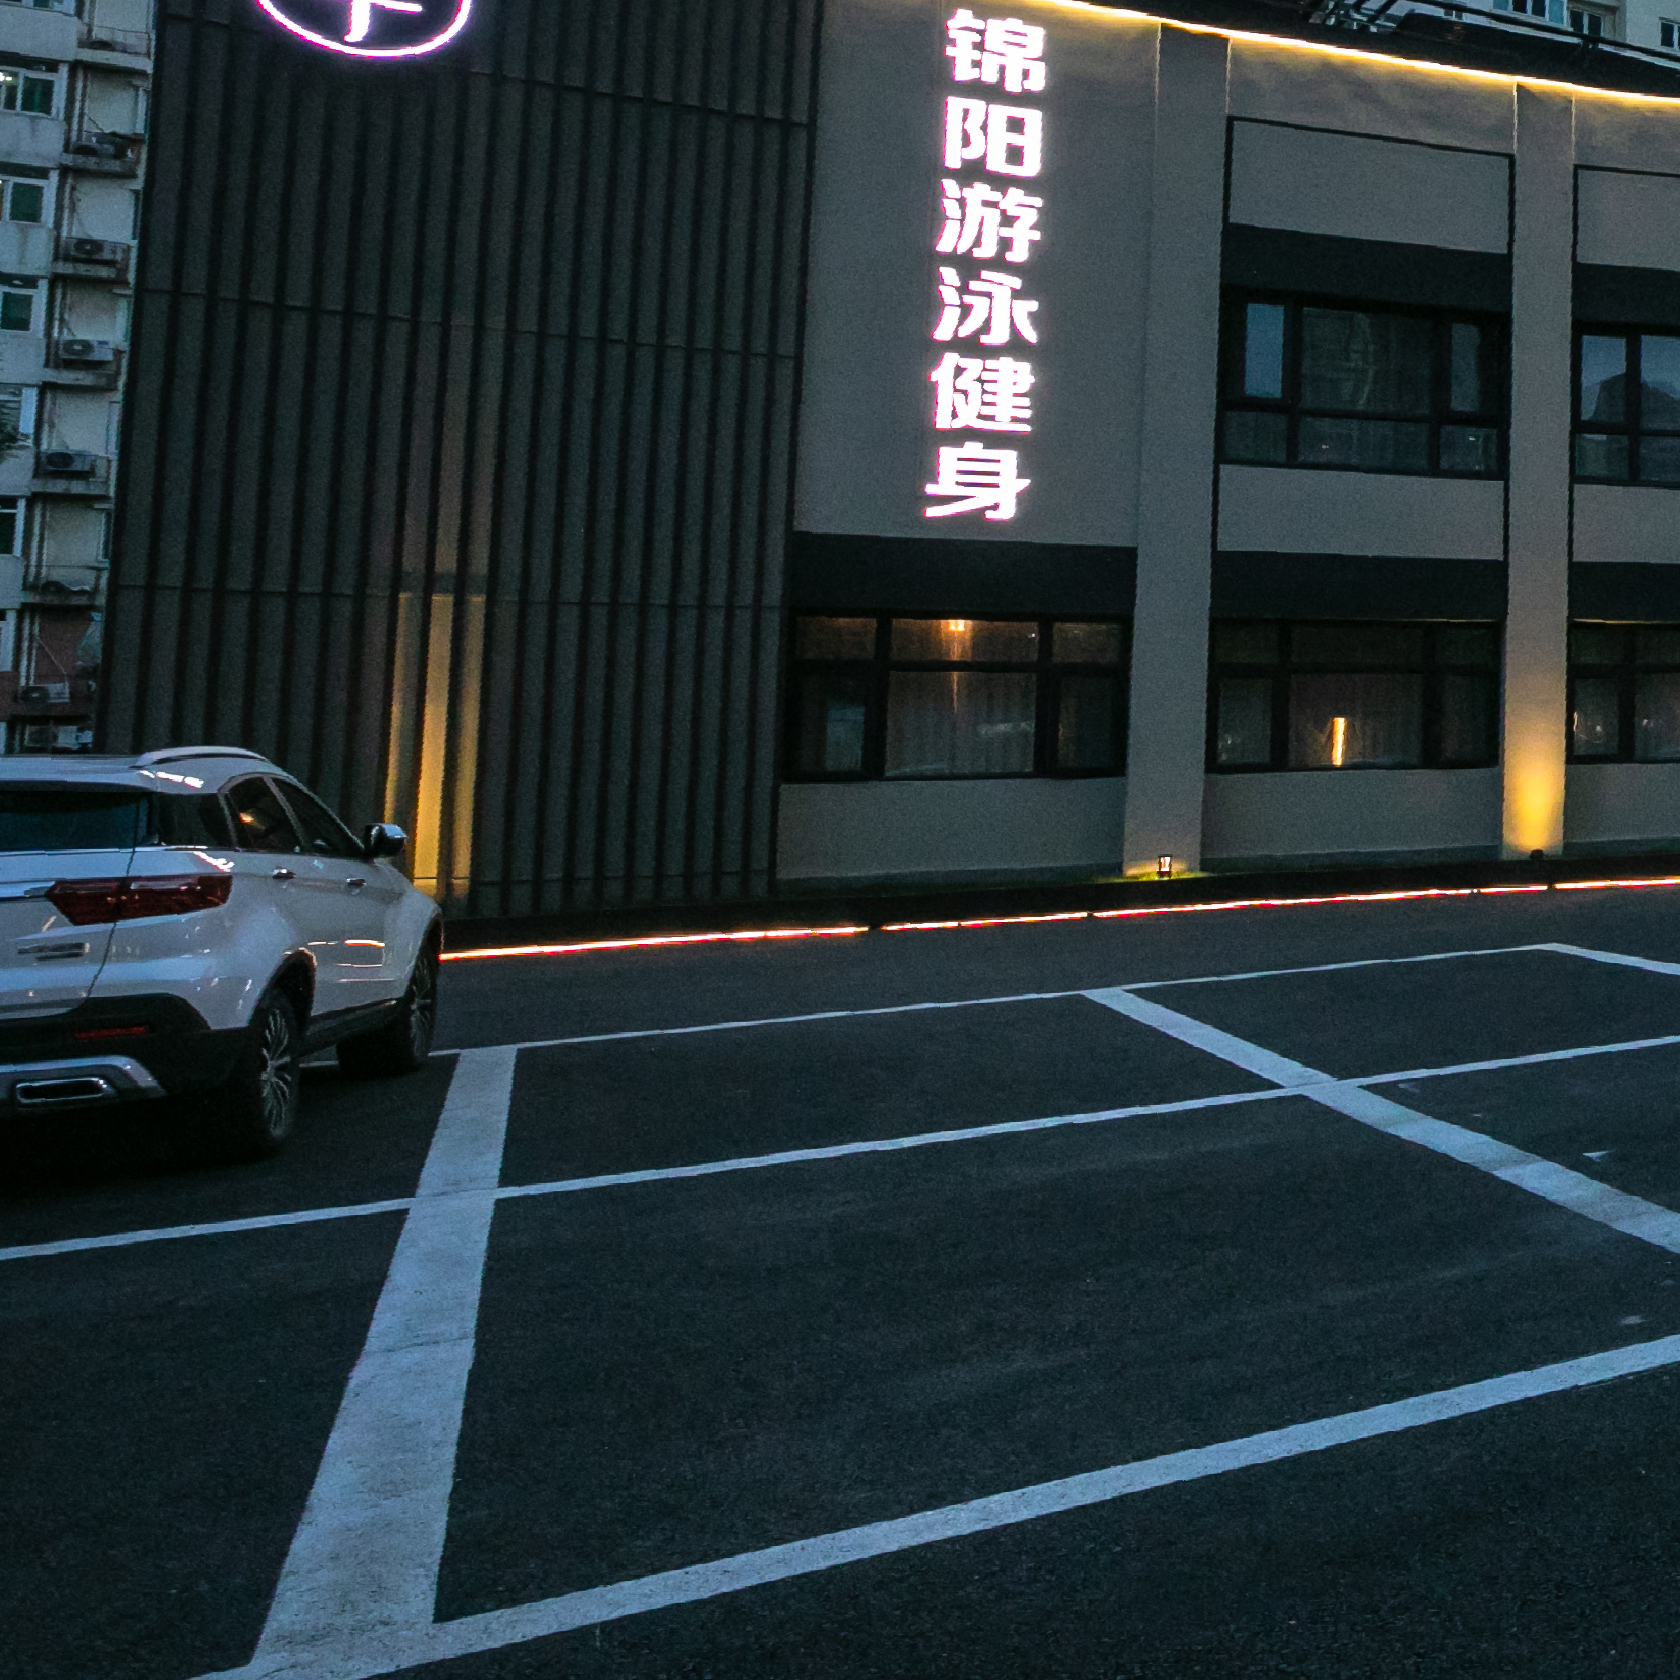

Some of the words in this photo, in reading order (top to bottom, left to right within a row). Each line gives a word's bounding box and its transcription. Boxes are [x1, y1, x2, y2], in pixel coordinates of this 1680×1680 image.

[923, 8, 1047, 521] 锦阳游泳健身
